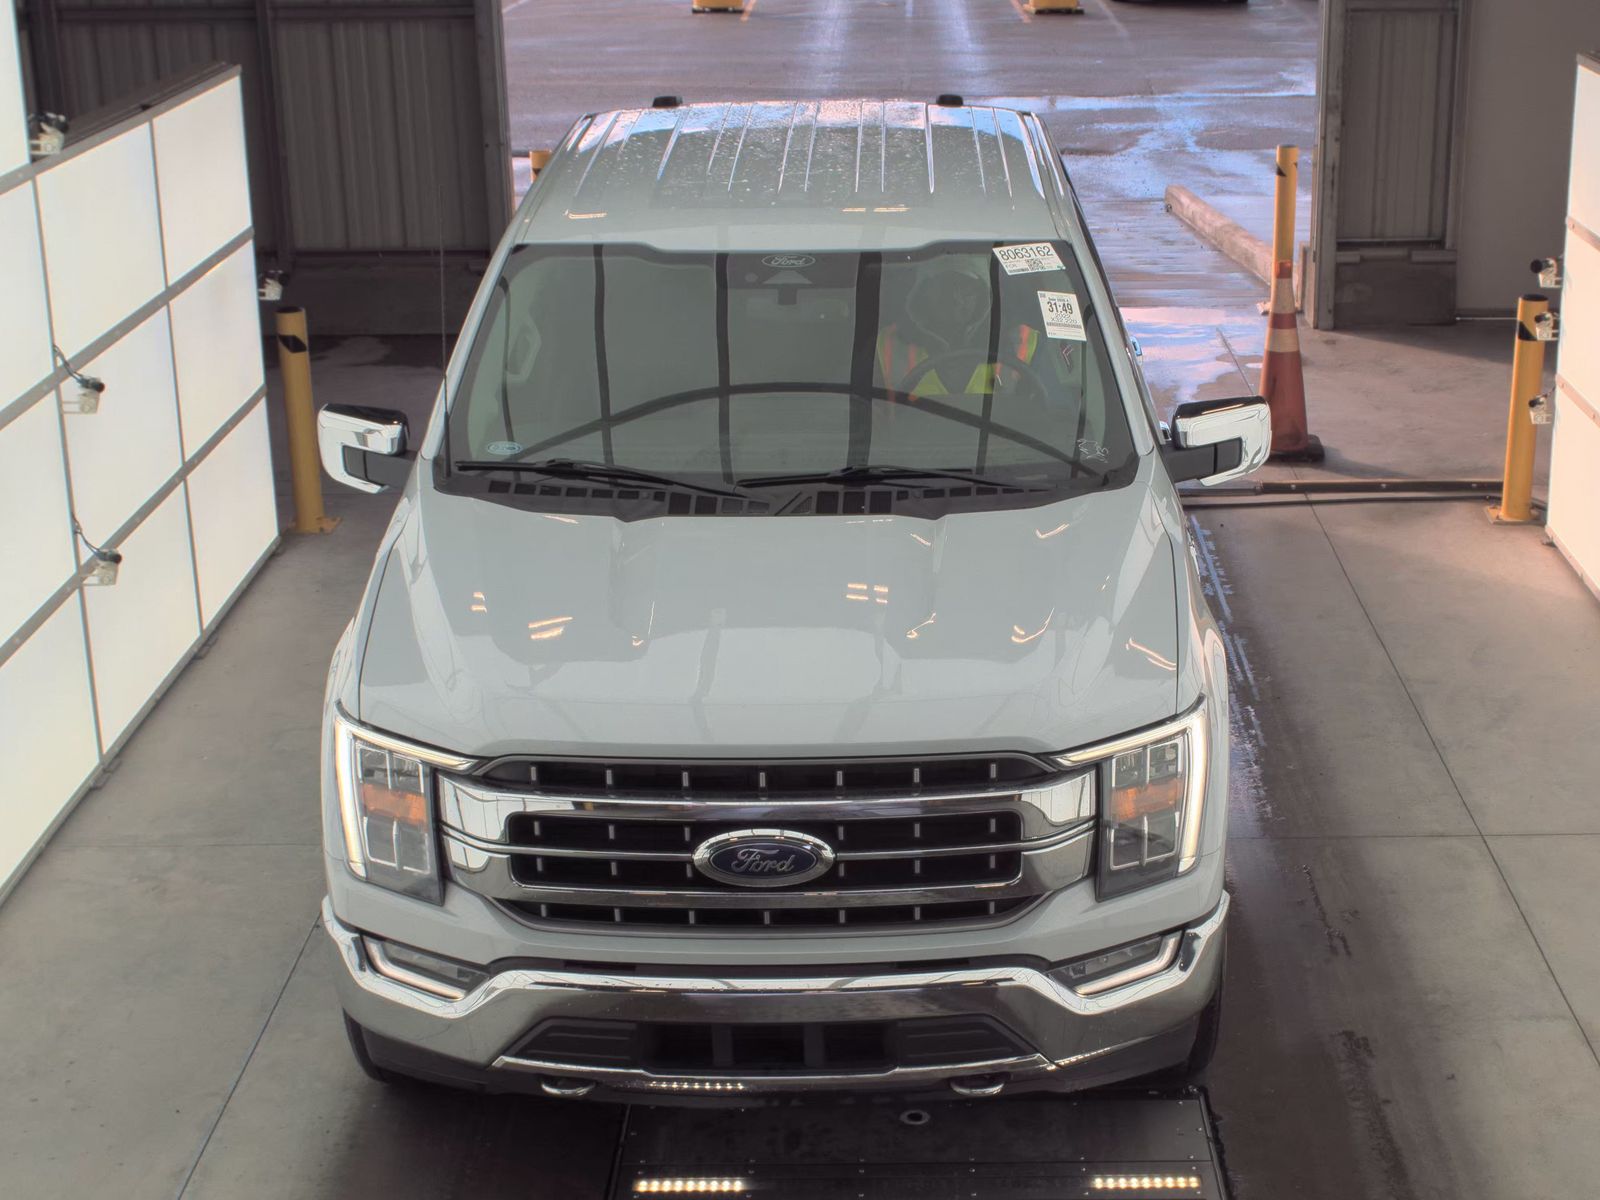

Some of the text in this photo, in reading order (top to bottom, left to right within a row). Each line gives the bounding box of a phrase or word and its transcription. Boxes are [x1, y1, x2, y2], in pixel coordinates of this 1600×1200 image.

[770, 255, 806, 266] Ford
[999, 246, 1053, 261] 8063162
[1047, 301, 1073, 315] 31:49
[731, 848, 796, 872] Ford
